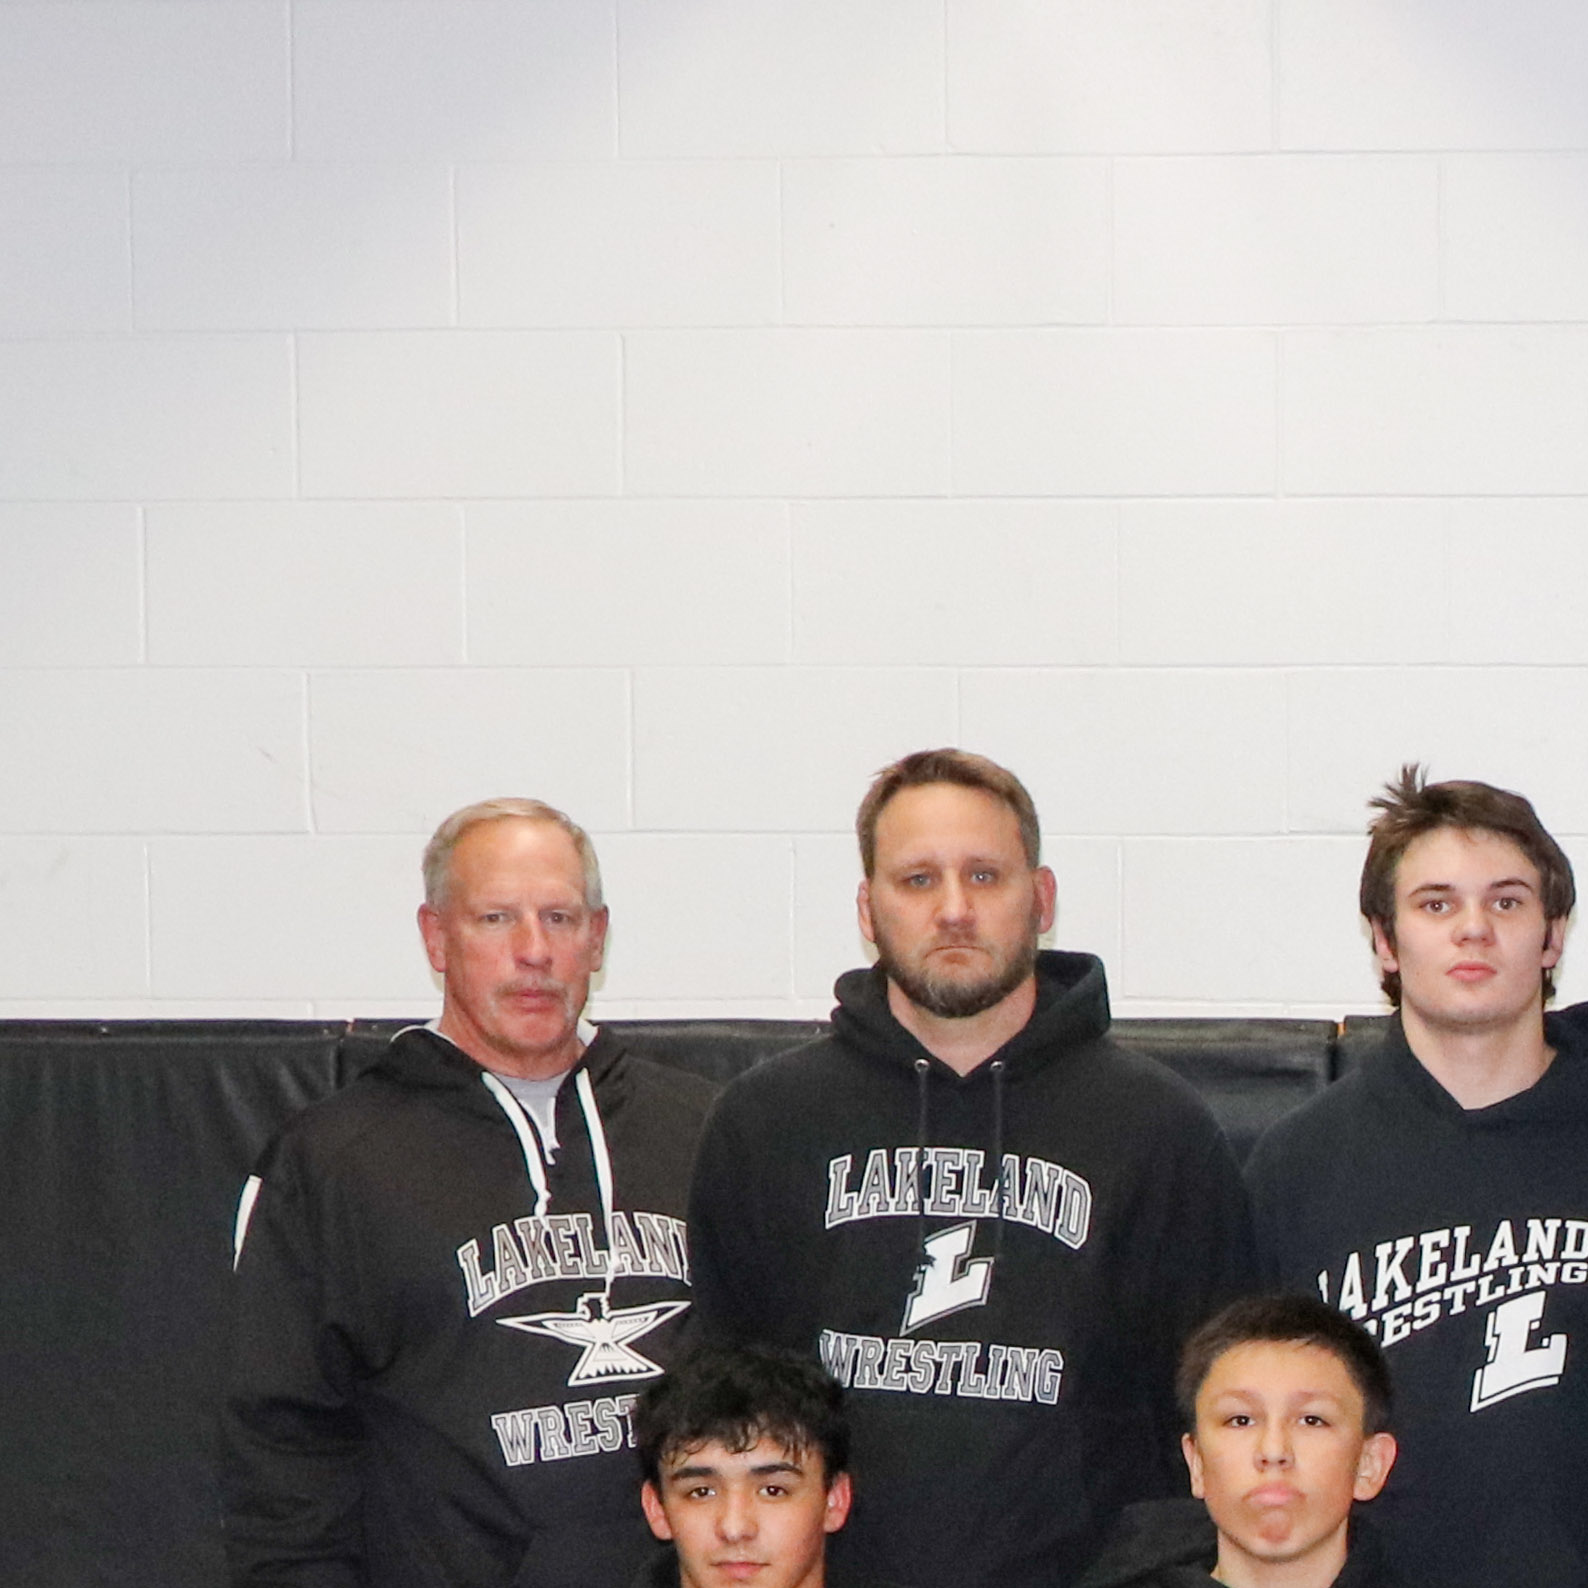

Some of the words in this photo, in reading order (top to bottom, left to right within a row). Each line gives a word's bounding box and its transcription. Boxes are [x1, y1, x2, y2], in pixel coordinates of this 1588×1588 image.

[824, 1146, 1092, 1250] LAKELAND
[457, 1211, 692, 1318] LAKELAN
[1363, 1262, 1588, 1348] ESTLING
[818, 1329, 1063, 1405] WRESTLING
[491, 1393, 640, 1466] WREST
